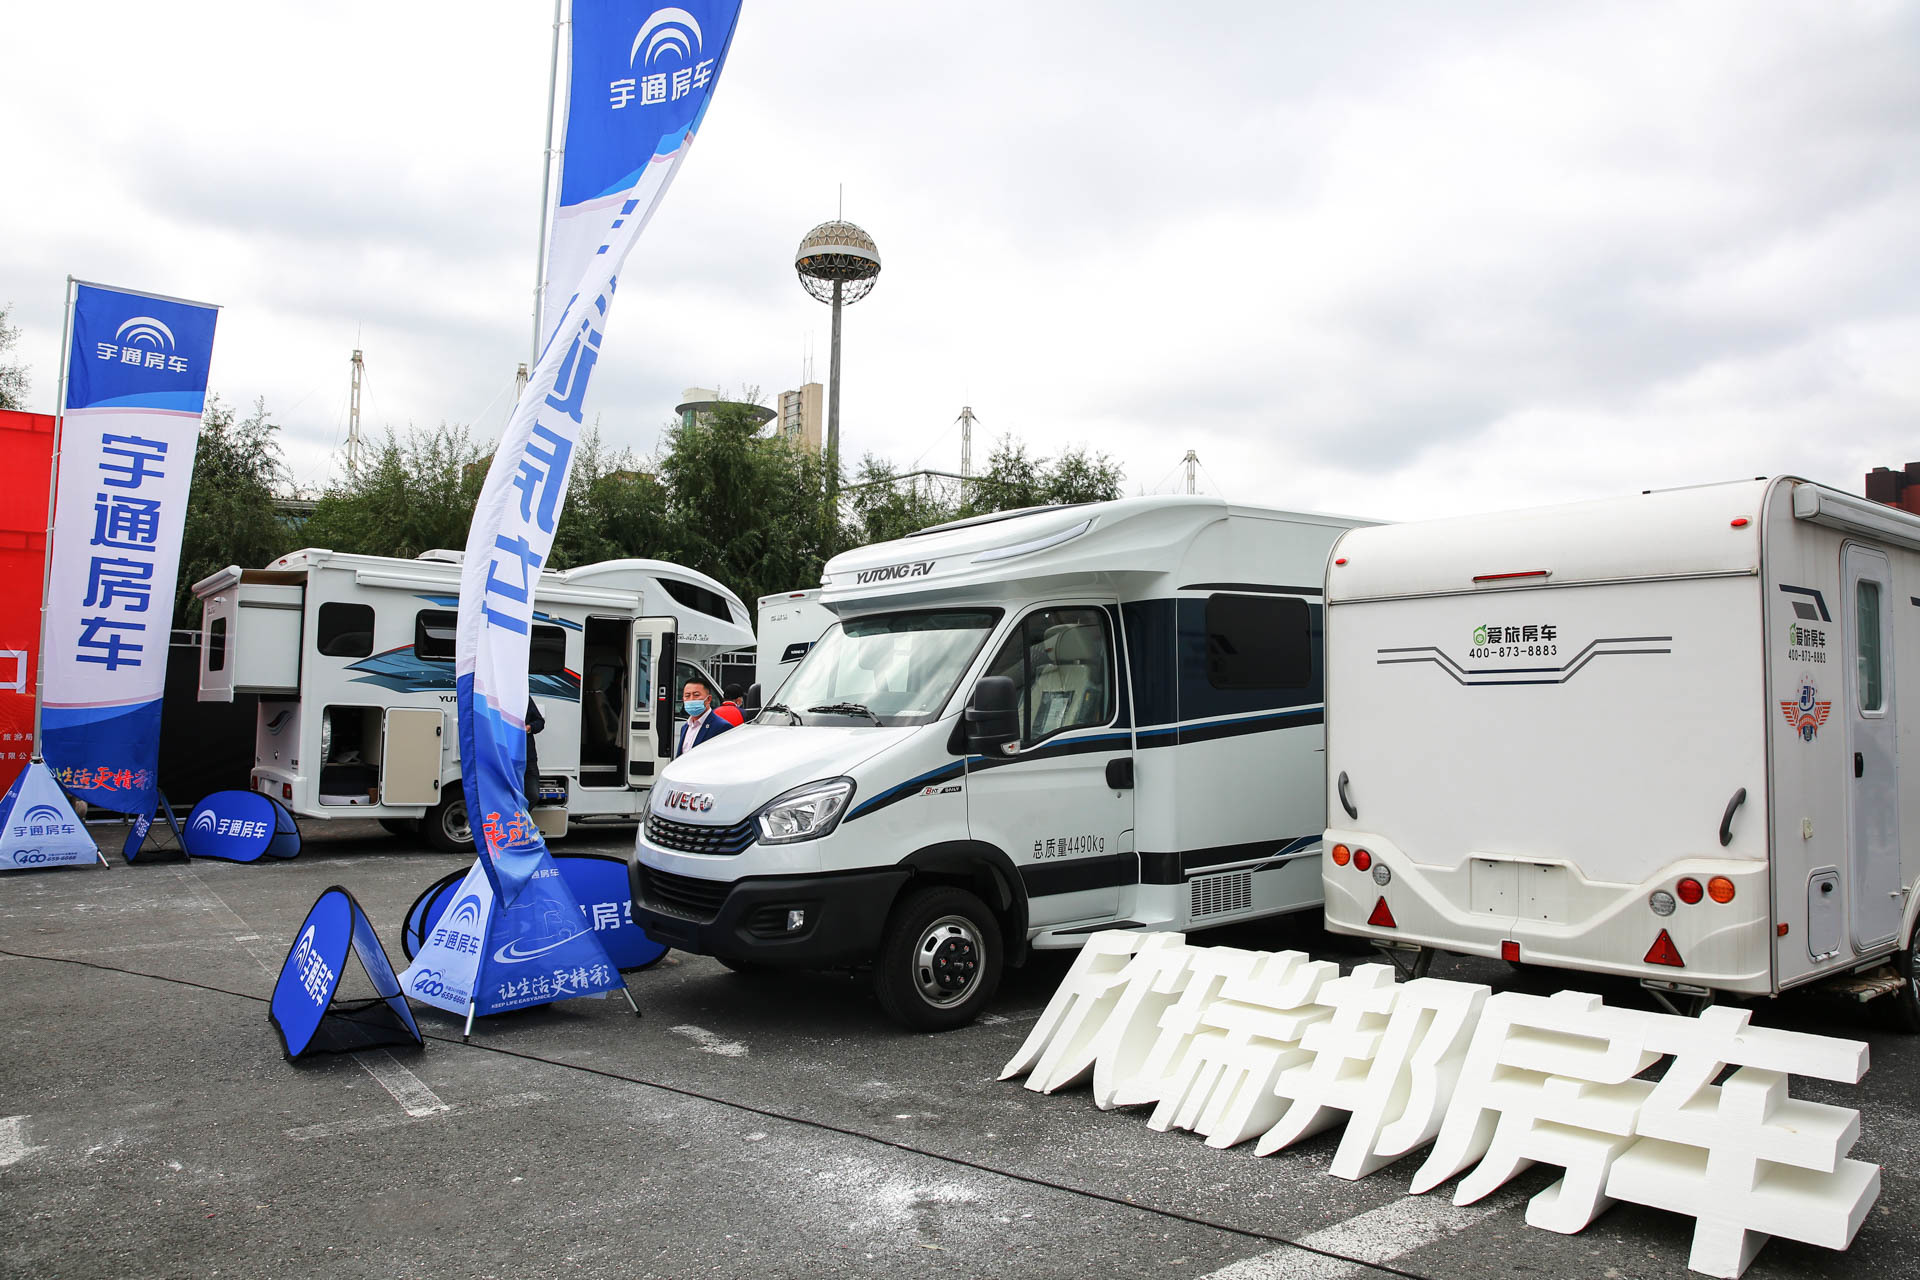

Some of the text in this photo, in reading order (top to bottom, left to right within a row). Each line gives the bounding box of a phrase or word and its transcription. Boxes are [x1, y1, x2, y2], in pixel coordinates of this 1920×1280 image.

[609, 58, 714, 109] 宇通房车
[96, 342, 188, 373] 宇通房车
[75, 432, 169, 672] 宇通房车
[856, 561, 936, 584] YUTONG RV
[1487, 624, 1557, 644] 爱旅房车
[1796, 627, 1826, 648] 爱旅房车
[1469, 645, 1557, 658] 400-873-8883
[1788, 648, 1827, 663] 400-873-8883
[664, 789, 715, 813] IVECO
[13, 824, 76, 838] 宇通房车
[216, 818, 268, 839] 宇通房车
[433, 928, 480, 956] 宇通房车
[300, 948, 334, 1007] 宇通房车
[414, 978, 444, 997] 400
[498, 963, 611, 1001] 让生活更精彩
[505, 998, 519, 1007] LIFE
[996, 930, 1882, 1278] 欣瑞邦房车
